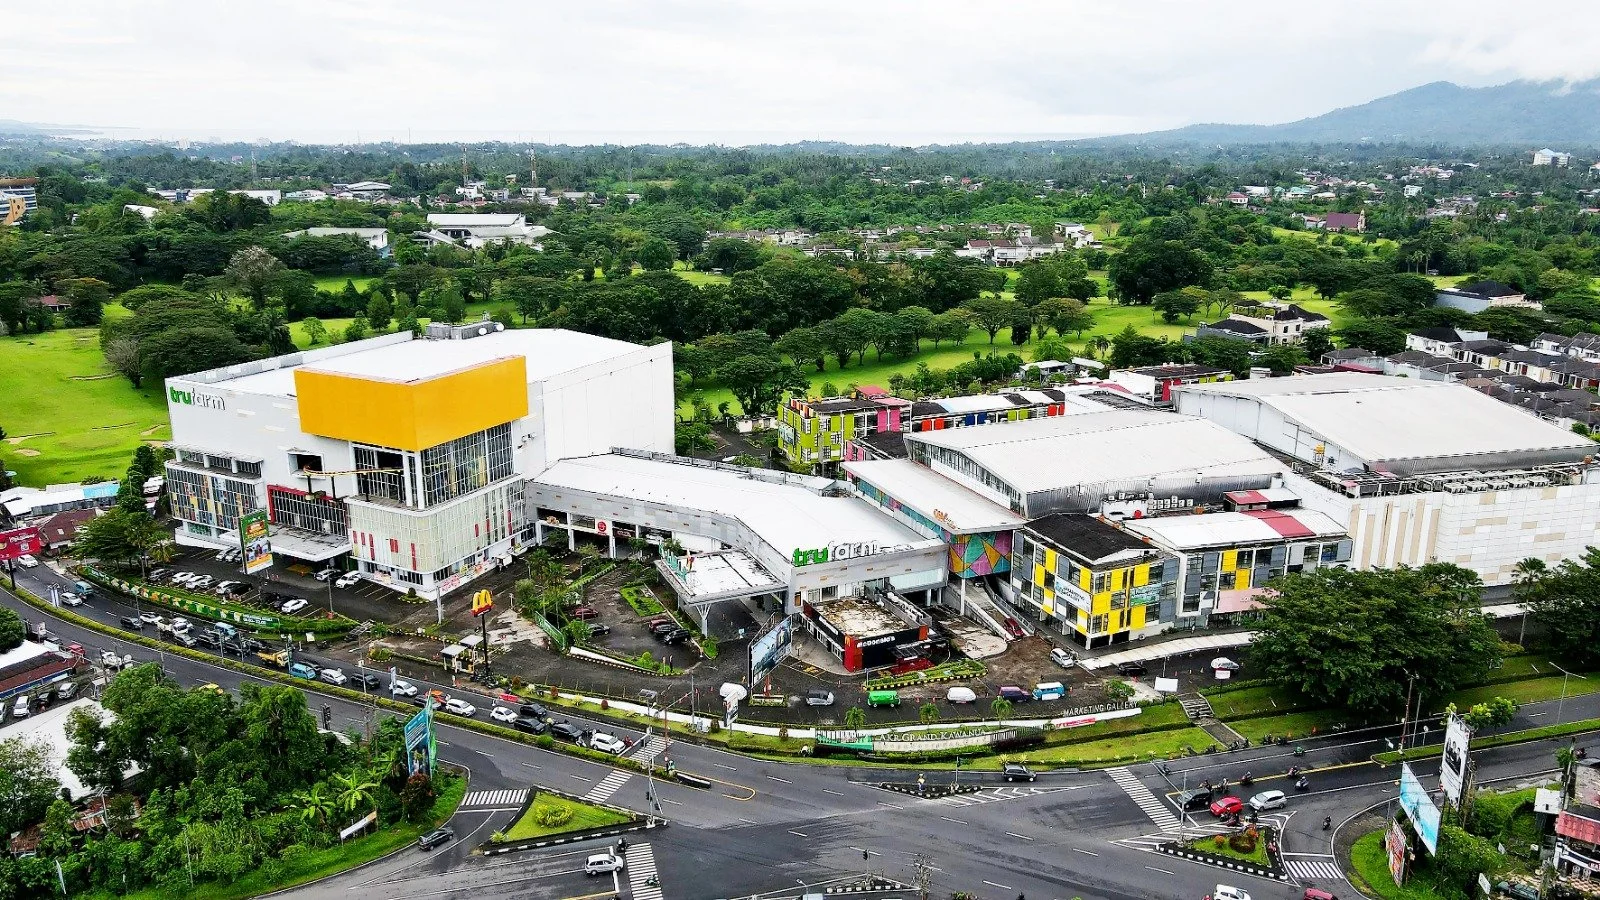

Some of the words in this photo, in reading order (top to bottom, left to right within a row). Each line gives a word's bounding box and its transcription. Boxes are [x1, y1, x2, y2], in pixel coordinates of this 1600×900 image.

[169, 386, 226, 410] trufarm
[1063, 704, 1105, 717] MARKETING
[1106, 701, 1138, 712] GALLERY
[902, 732, 938, 742] GRAND
